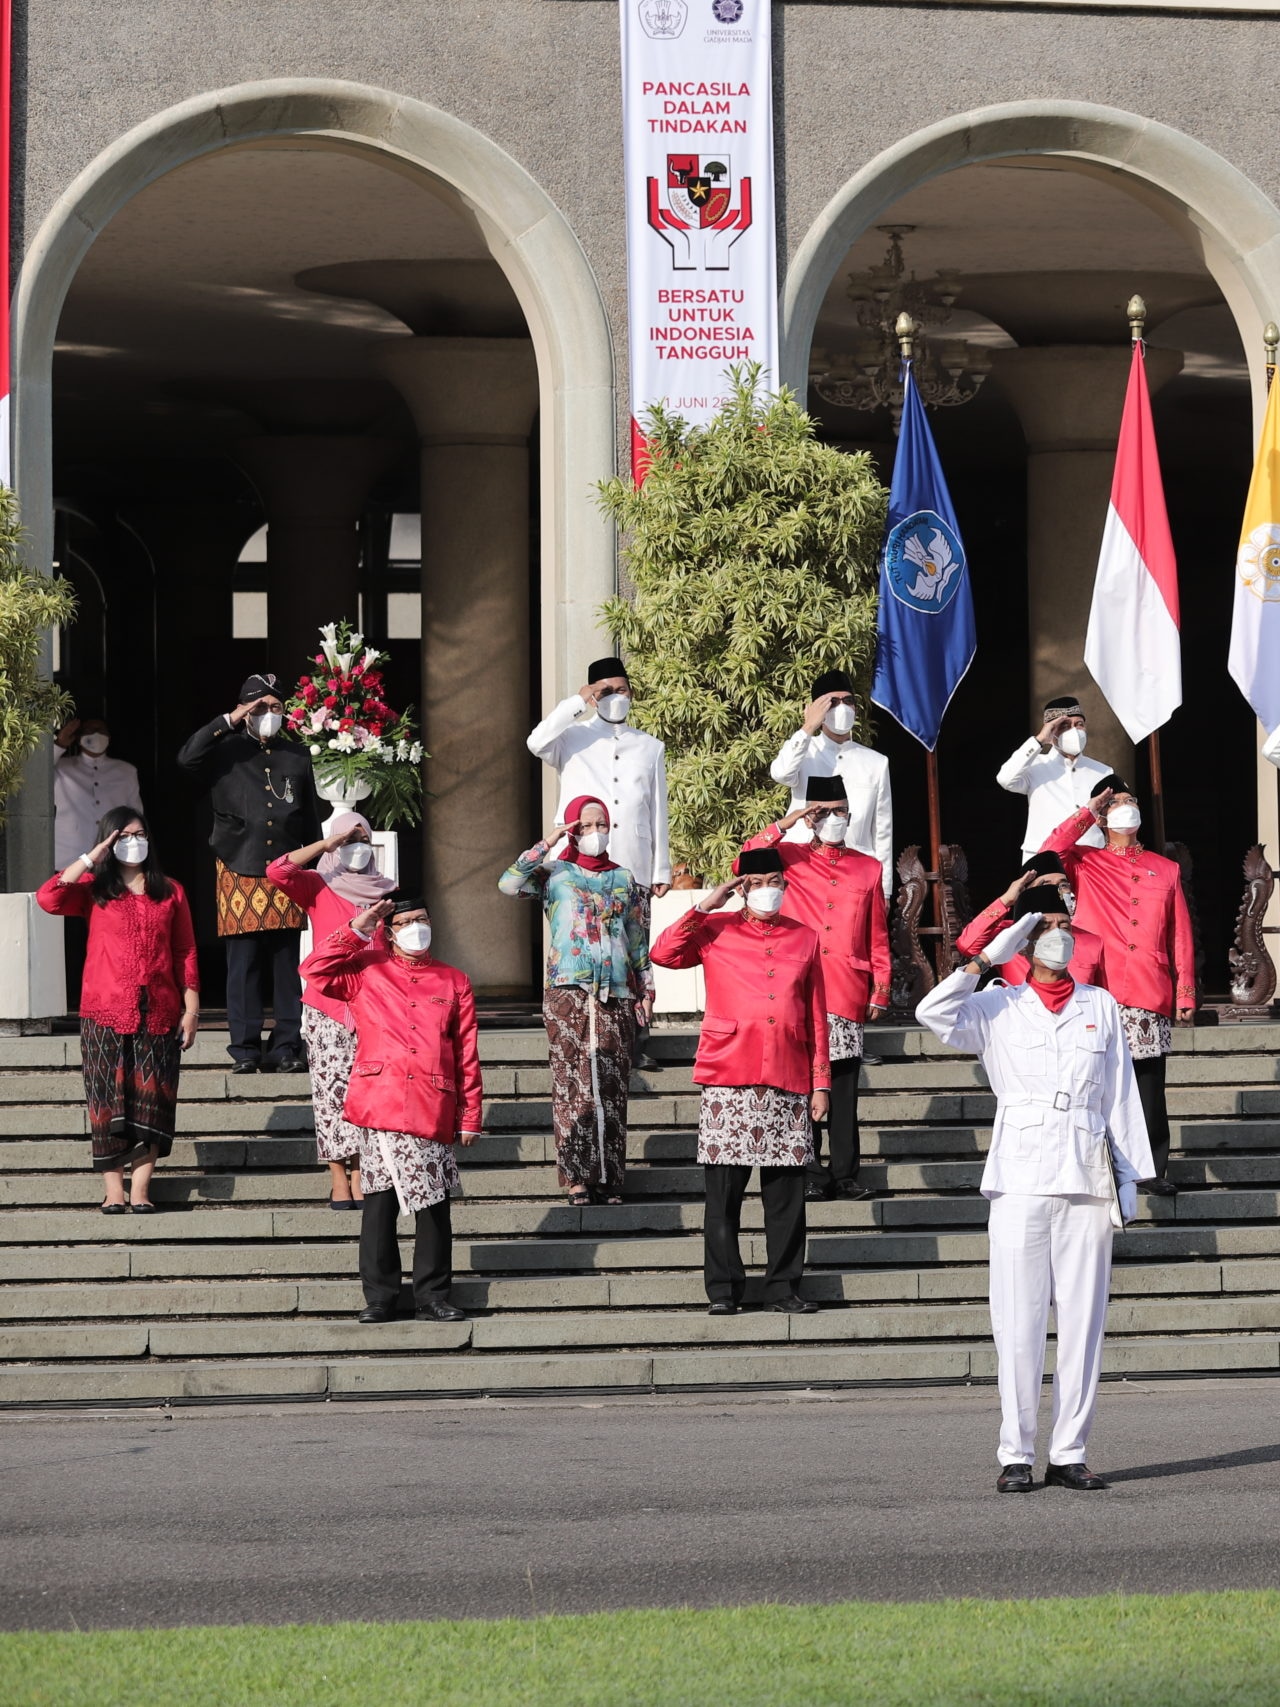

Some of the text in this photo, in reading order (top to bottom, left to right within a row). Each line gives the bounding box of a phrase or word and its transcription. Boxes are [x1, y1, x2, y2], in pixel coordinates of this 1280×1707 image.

[642, 82, 751, 96] PANCASILA
[663, 101, 730, 114] DALAM
[647, 119, 747, 134] TINDAKAN
[658, 289, 744, 303] BERSATU
[668, 308, 735, 322] UNTUK
[650, 327, 755, 341] INDONESIA
[656, 346, 749, 360] TANGGUH
[675, 397, 708, 409] JUNI
